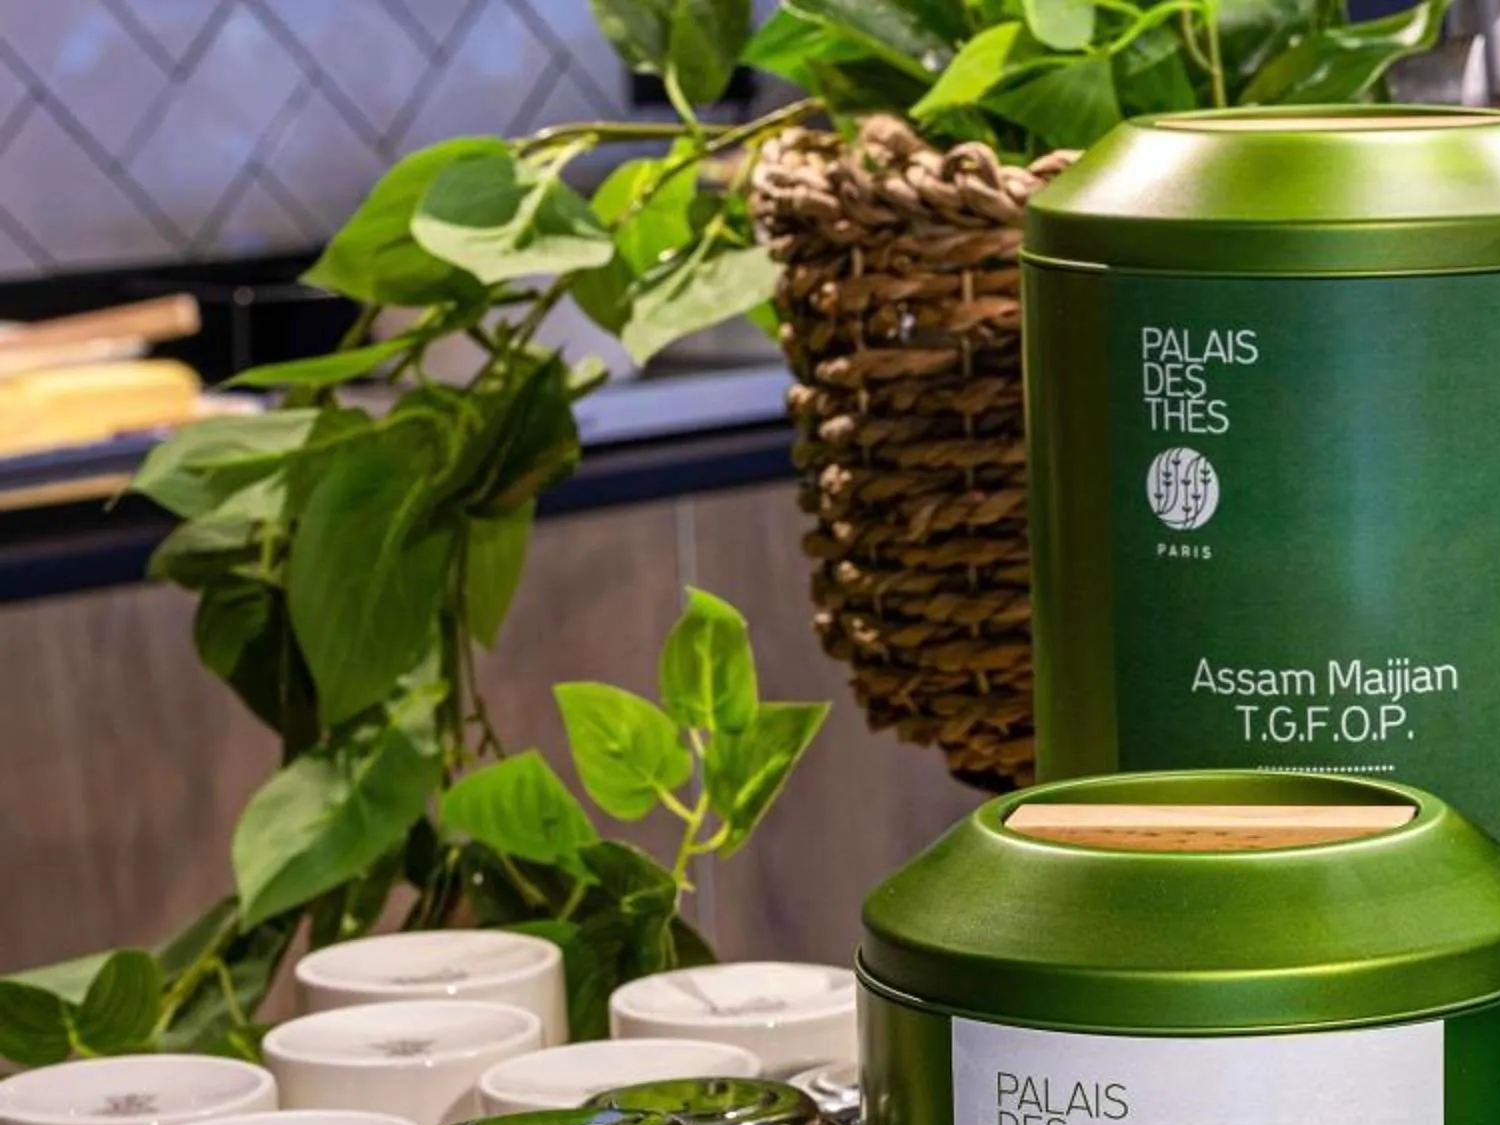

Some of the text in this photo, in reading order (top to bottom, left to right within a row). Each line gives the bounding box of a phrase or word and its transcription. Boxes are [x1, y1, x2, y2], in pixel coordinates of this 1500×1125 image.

[1142, 327, 1259, 365] PALAIS
[1143, 363, 1207, 398] DES
[1144, 393, 1229, 434] THÉS
[1157, 543, 1212, 560] PARIS
[1191, 657, 1458, 703] Assam Maijian
[1236, 705, 1414, 743] T.G.F.O.P.
[997, 1072, 1129, 1119] PALAIS
